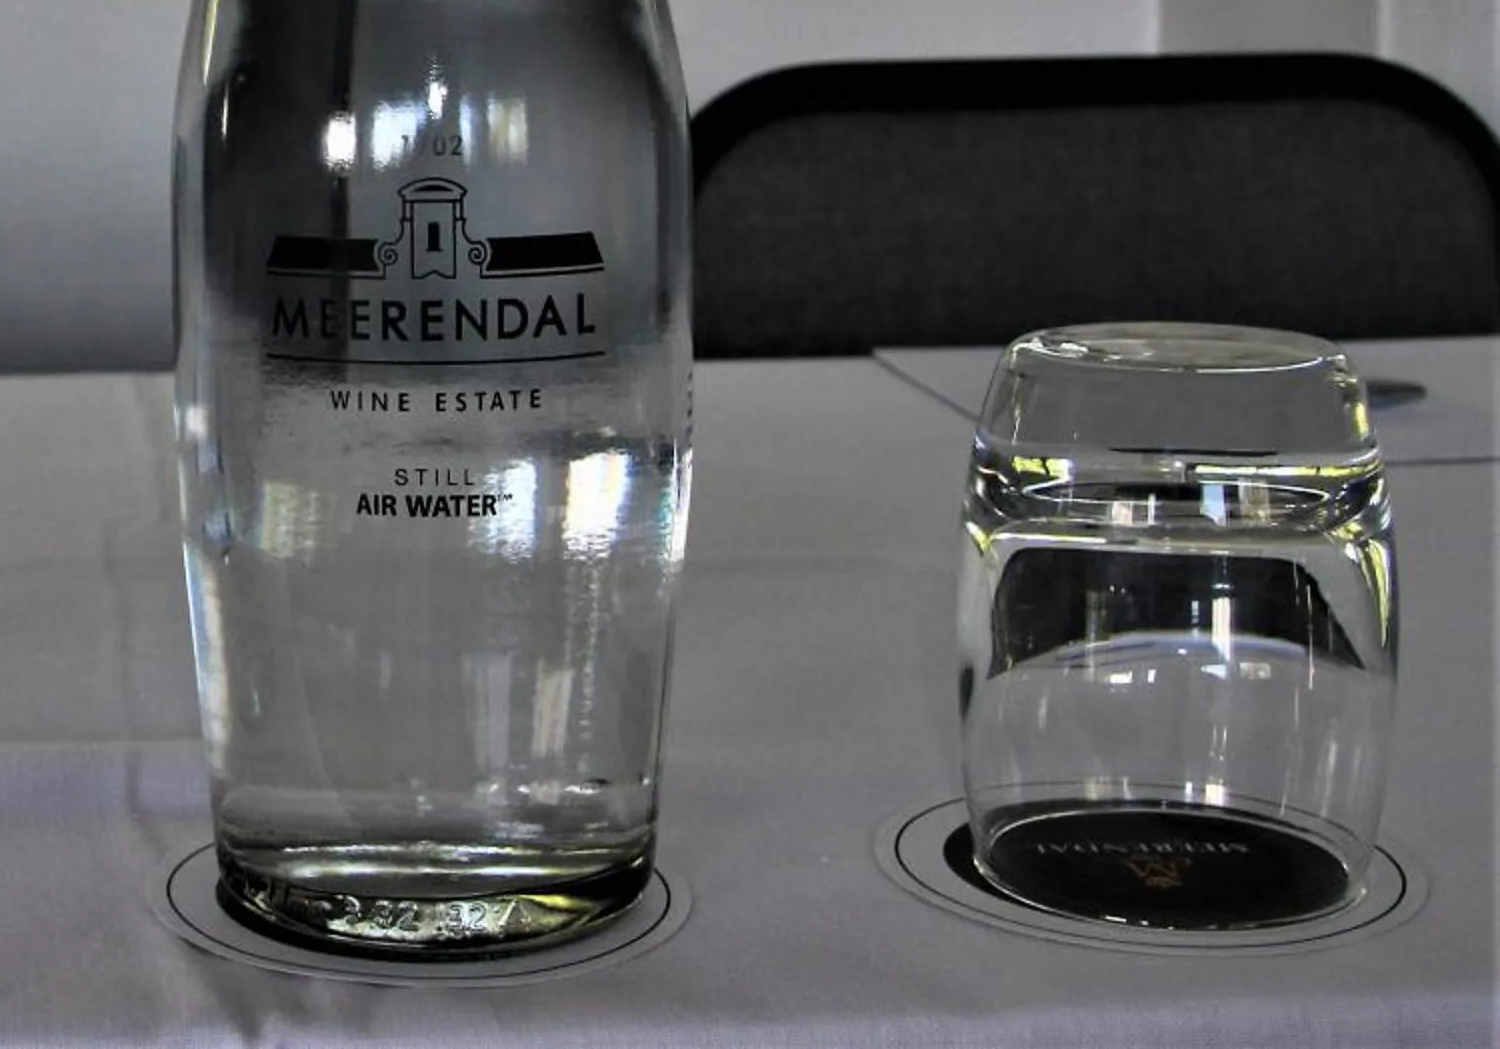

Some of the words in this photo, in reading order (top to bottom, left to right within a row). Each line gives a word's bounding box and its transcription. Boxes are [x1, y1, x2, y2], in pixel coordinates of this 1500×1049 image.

[401, 135, 463, 156] 102
[272, 293, 596, 342] MEERENDAL
[330, 391, 410, 412] WINE
[435, 389, 542, 412] ESTATE
[394, 468, 475, 487] STILL
[356, 493, 397, 516] AIR
